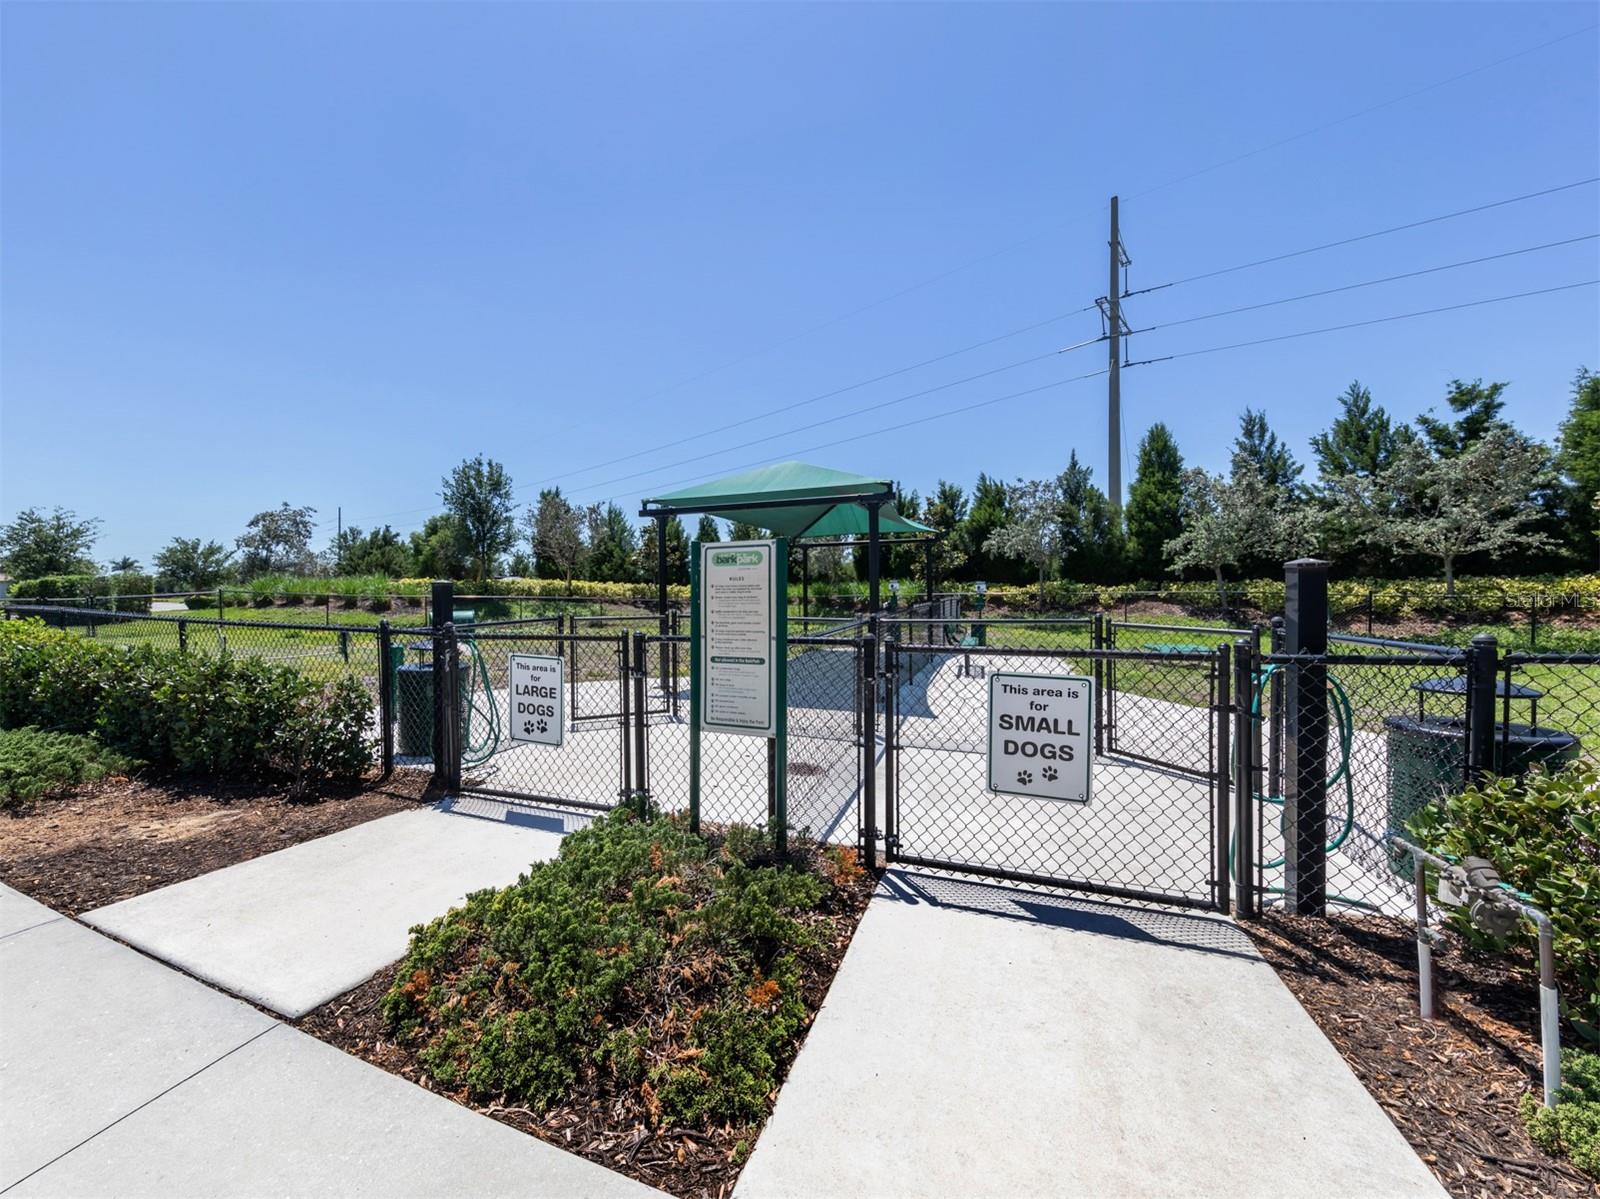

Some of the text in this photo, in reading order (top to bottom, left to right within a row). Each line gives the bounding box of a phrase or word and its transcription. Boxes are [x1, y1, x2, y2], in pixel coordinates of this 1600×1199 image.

[516, 662, 556, 673] This area is
[530, 674, 541, 682] for
[516, 684, 557, 699] LARGE
[1001, 684, 1079, 699] This area is
[518, 702, 554, 717] DOGS
[1030, 701, 1049, 711] for
[999, 714, 1081, 736] SMALL
[1004, 740, 1074, 761] DOGS
